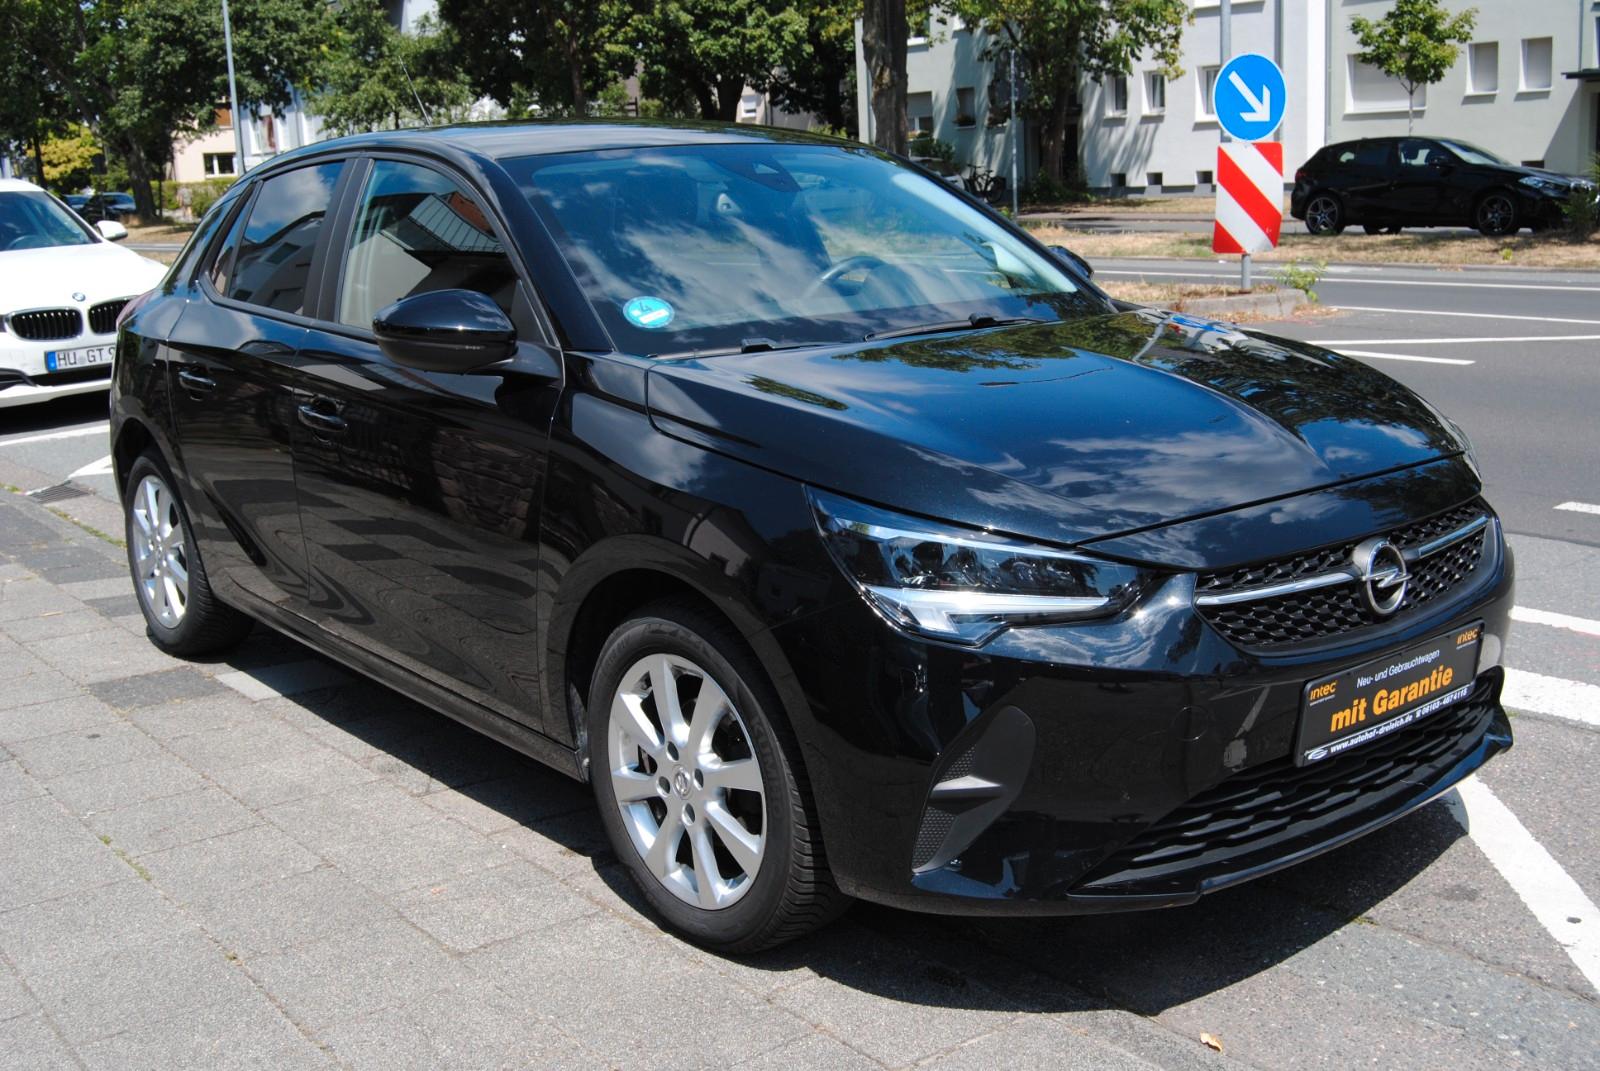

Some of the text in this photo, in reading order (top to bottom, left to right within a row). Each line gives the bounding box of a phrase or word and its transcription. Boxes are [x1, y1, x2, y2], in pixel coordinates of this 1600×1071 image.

[57, 351, 77, 366] HU
[86, 347, 104, 363] GT
[1356, 649, 1441, 689] Neu- und Gebrauchtwagen
[1309, 681, 1338, 701] intec
[1330, 664, 1454, 733] mit Garantie
